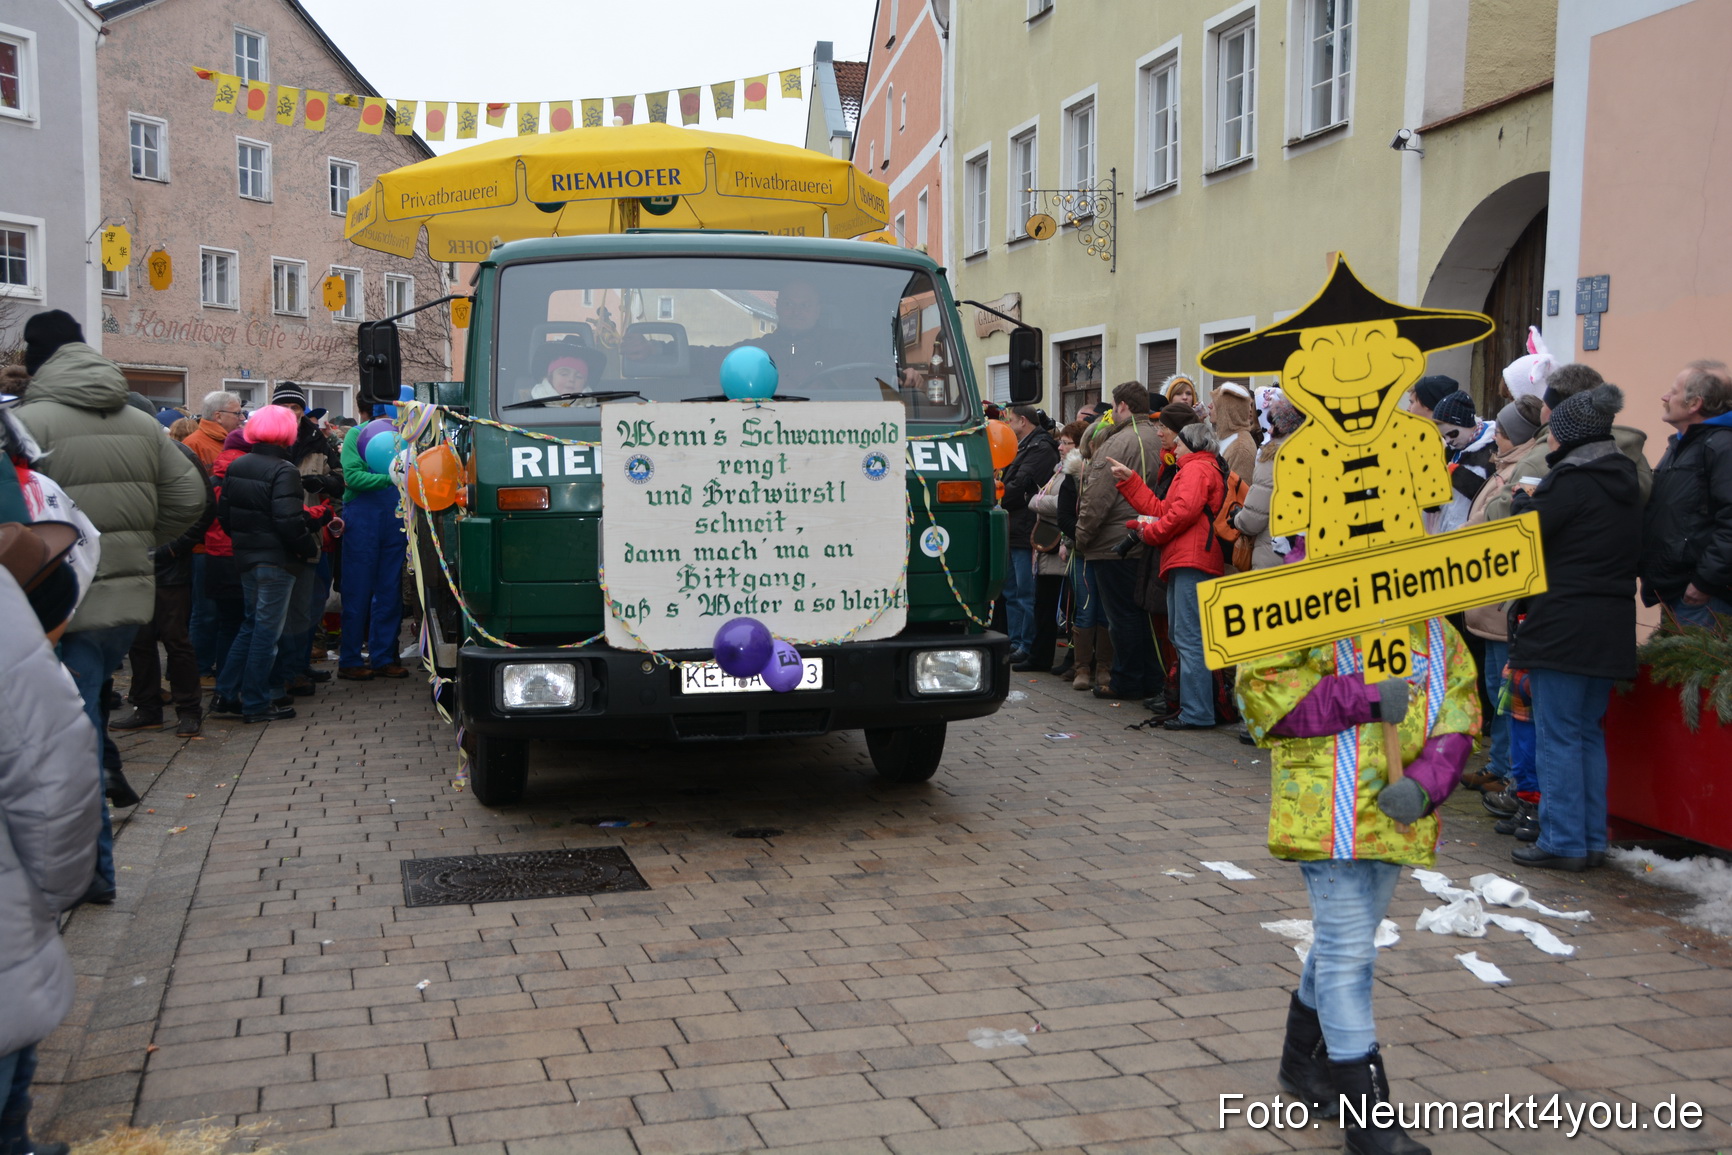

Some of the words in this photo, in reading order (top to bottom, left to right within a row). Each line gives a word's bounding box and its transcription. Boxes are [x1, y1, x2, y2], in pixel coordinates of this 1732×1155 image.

[401, 180, 499, 210] Privatbrauerei
[551, 168, 682, 192] RIEMHOFER
[733, 171, 834, 195] Privatbrauerei
[135, 308, 238, 345] Konditorei
[246, 319, 287, 349] Cafe
[616, 417, 728, 449] Wenn's
[739, 416, 900, 449] Schwanengold
[717, 452, 790, 480] rengt
[645, 483, 693, 506] und
[702, 477, 847, 508] Bratwürstl
[623, 542, 682, 564] dann
[773, 543, 810, 560] ma
[823, 542, 855, 559] an
[675, 563, 817, 594] Bittgang,
[1223, 576, 1361, 639] Brauerei
[1371, 547, 1520, 605] Riemhofer
[697, 592, 783, 618] Wetter
[793, 598, 806, 613] a
[811, 597, 836, 613] so
[1366, 638, 1408, 676] 46
